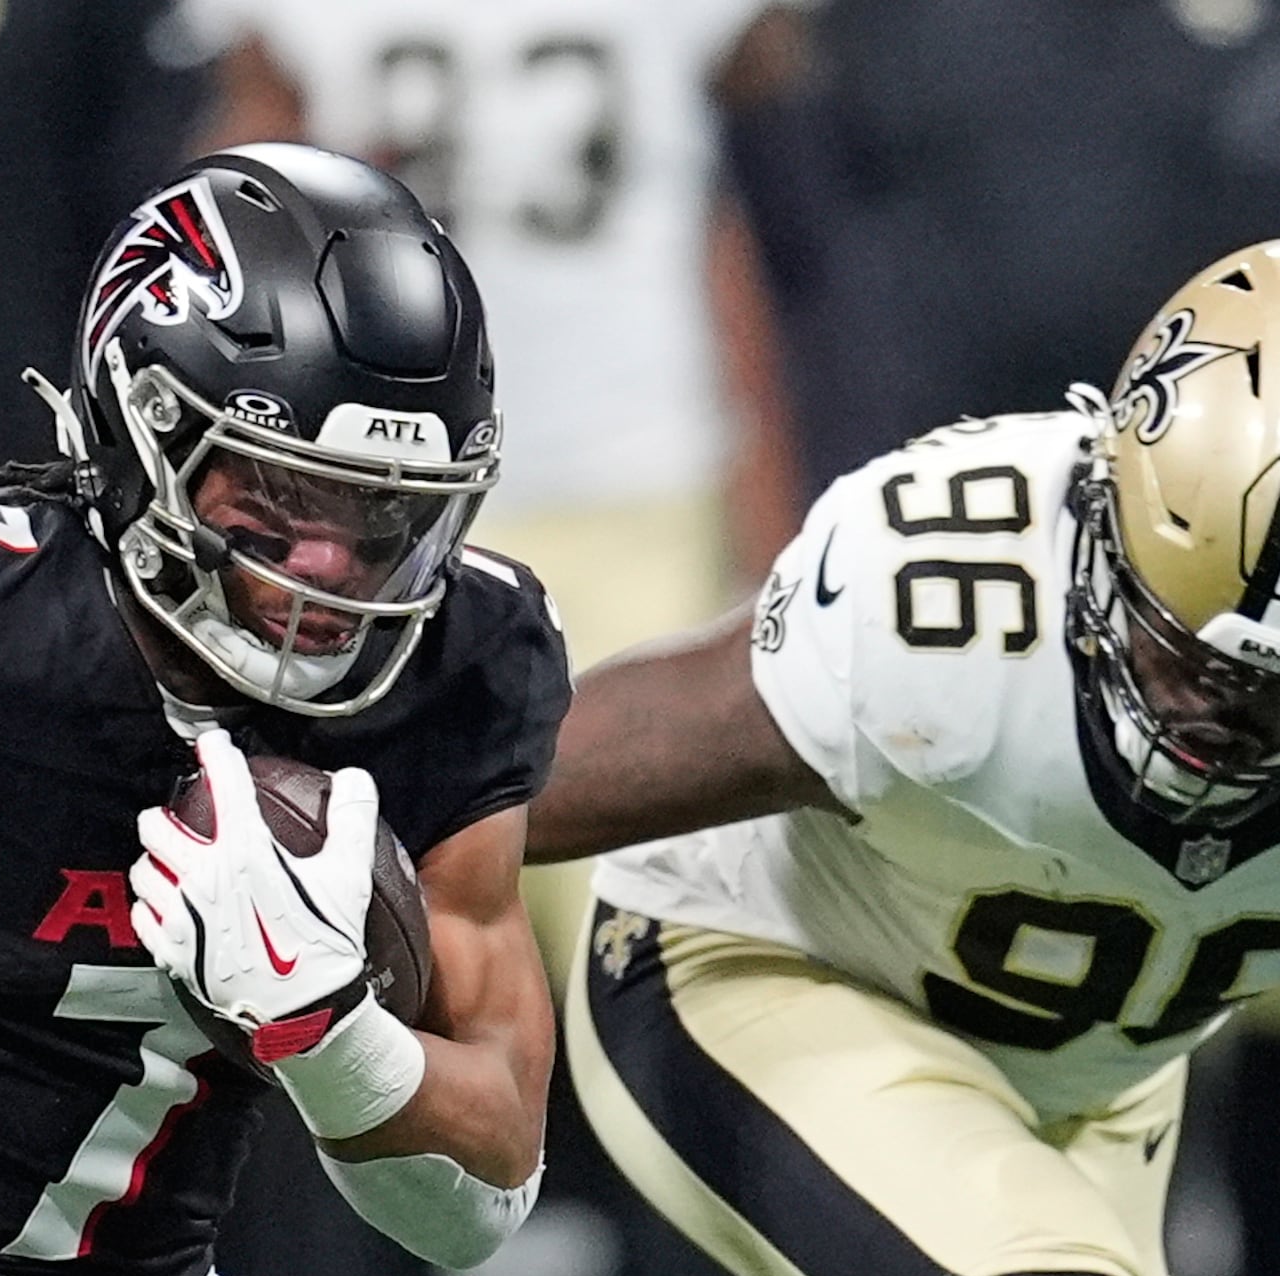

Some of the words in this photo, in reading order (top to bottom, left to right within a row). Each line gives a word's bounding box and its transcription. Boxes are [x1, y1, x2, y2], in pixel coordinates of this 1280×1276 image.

[366, 417, 427, 443] ATL
[880, 464, 1040, 657] 96
[1, 964, 216, 1258] 7
